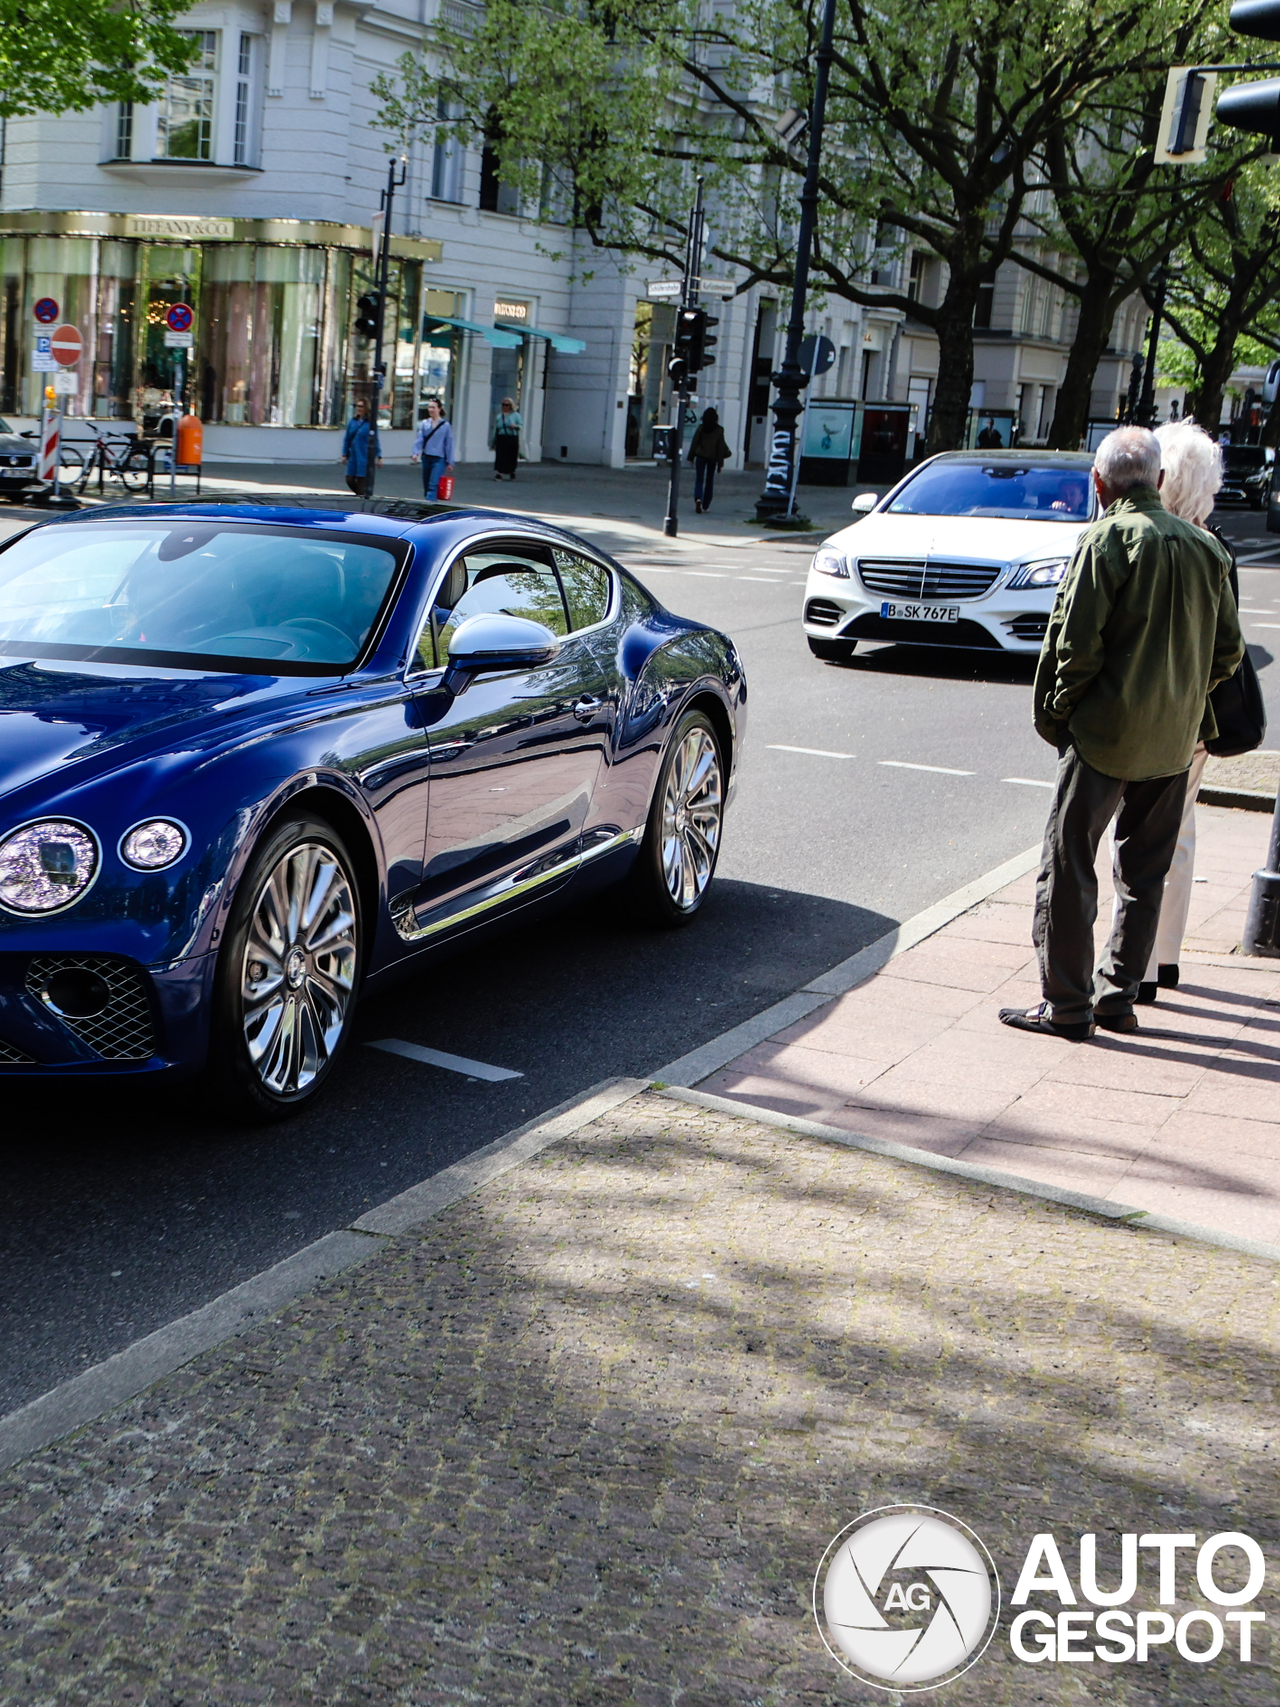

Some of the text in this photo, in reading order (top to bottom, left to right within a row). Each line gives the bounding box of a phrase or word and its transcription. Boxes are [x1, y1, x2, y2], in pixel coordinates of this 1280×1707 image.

[888, 604, 957, 621] B SK 767E
